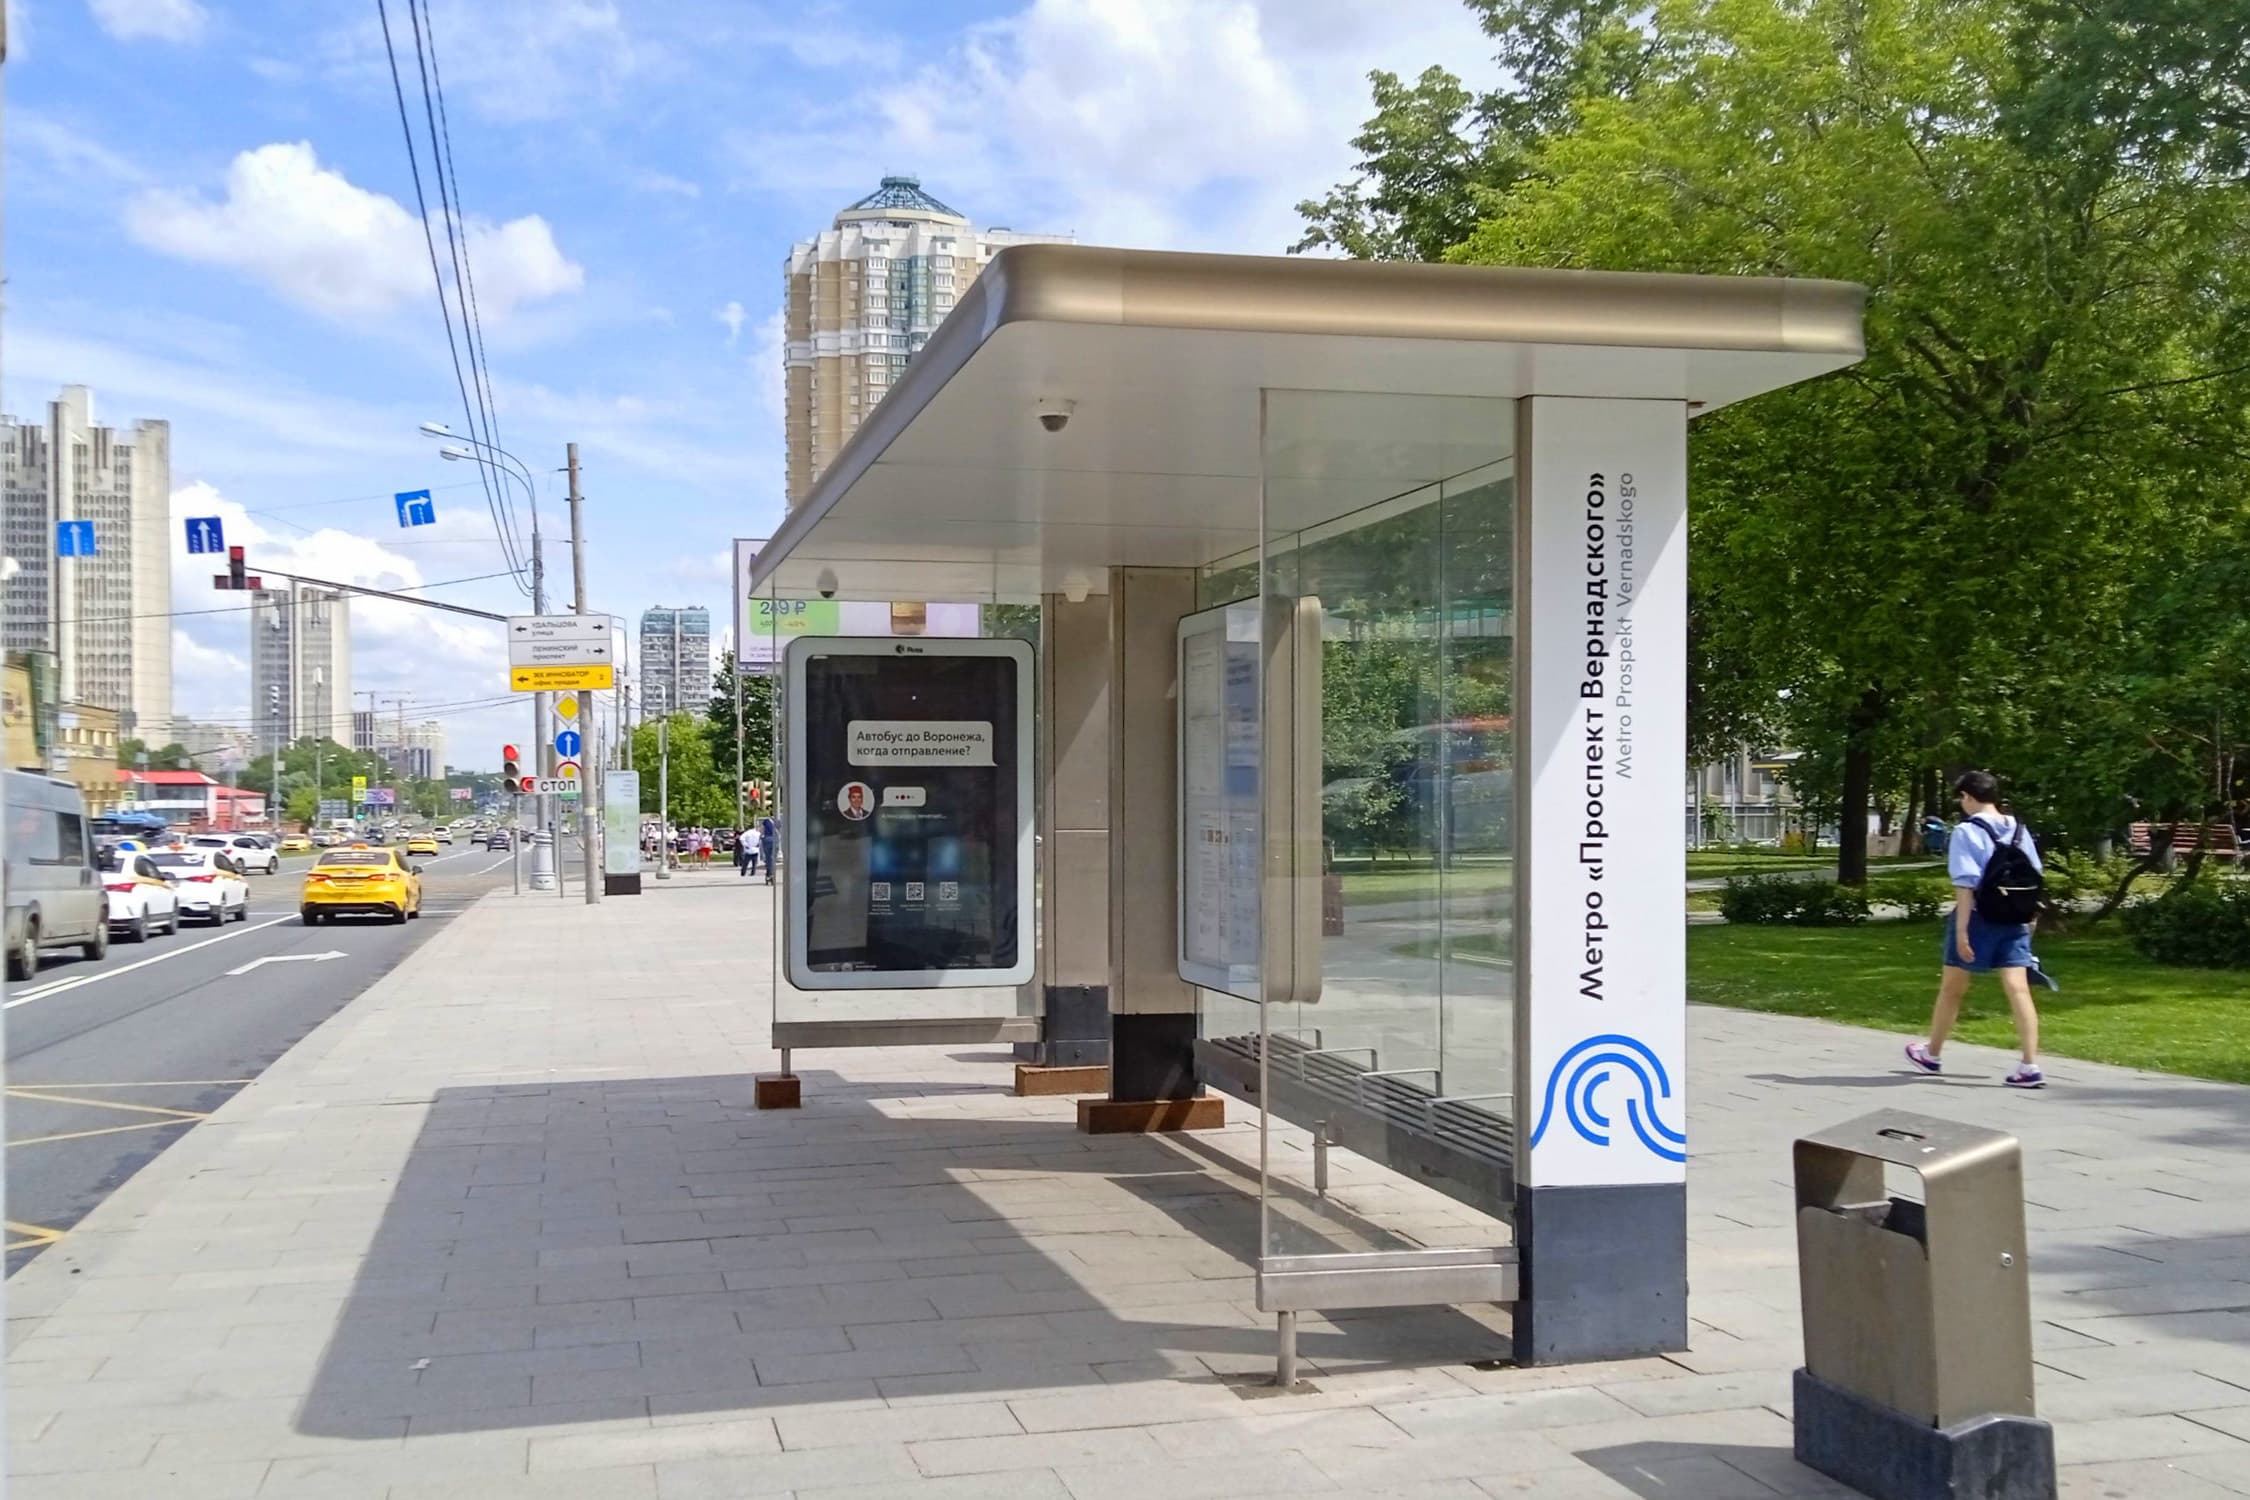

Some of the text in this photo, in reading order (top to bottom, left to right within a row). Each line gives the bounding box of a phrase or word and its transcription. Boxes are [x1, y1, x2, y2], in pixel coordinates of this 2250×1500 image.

[1615, 472, 1636, 779] Metro Prospekt Vernadskogo
[856, 731, 985, 743] Автобус до Воронежа,
[1579, 472, 1610, 1001] Метро «Проспект Вернадского»
[857, 745, 971, 757] когда отправление?
[540, 780, 576, 792] СТОП
